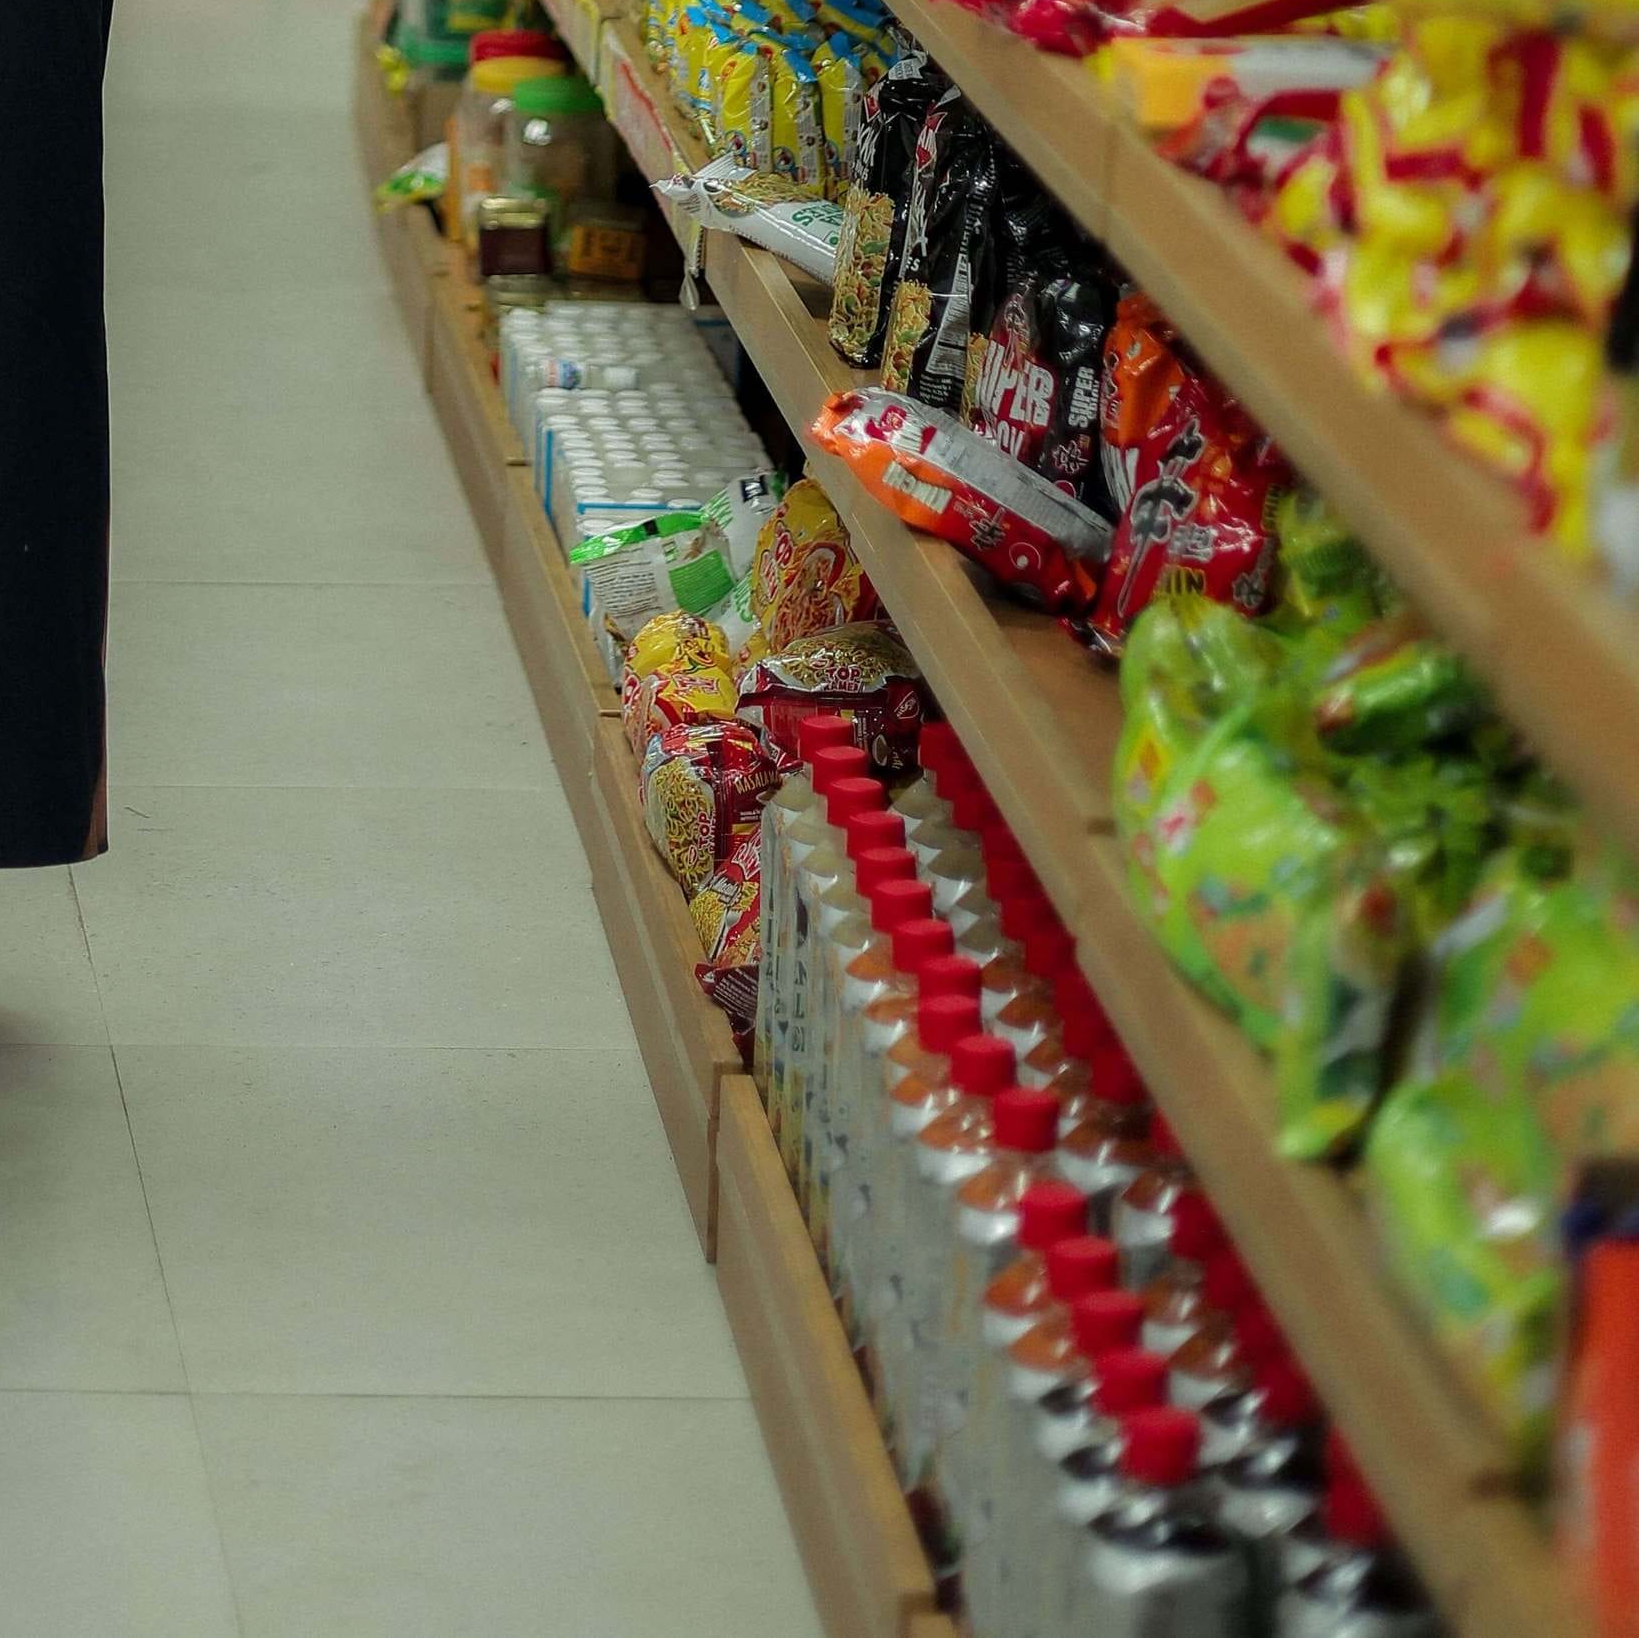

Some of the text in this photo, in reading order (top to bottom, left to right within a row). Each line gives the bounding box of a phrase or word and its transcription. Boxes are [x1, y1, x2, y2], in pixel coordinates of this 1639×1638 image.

[1068, 365, 1095, 428] SUPER
[824, 664, 862, 682] TOP
[697, 809, 712, 851] TOP
